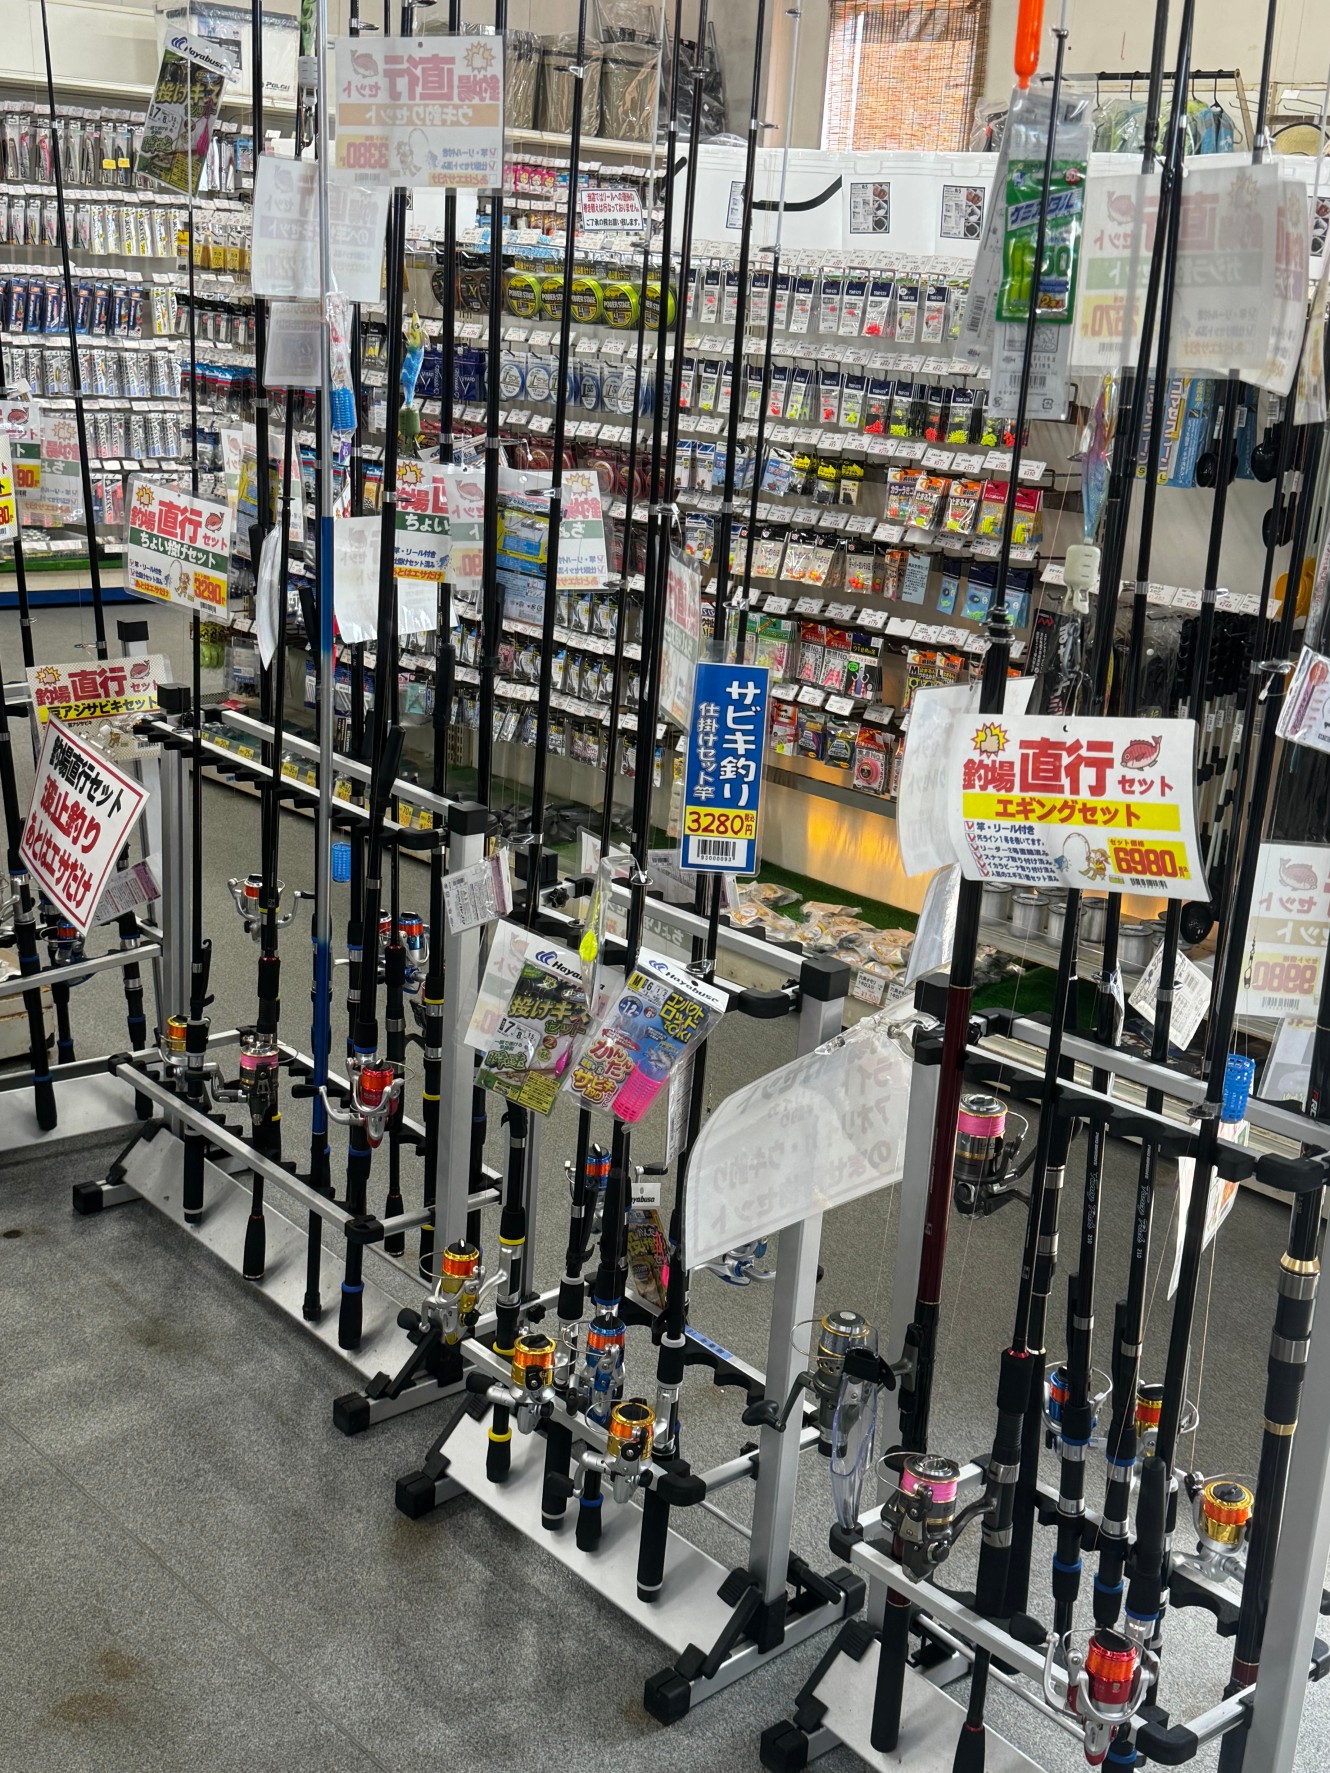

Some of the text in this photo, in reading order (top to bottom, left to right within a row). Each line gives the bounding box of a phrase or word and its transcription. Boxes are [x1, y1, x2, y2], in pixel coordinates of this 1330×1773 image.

[130, 499, 228, 551] 釣場直行セット
[134, 560, 162, 576] 竿・リール付き
[140, 531, 217, 569] ちょい投げセット
[134, 579, 170, 598] あとはエサだけ
[35, 667, 159, 706] 釣場直行セット
[693, 702, 721, 801] 仕掛けセット竿
[719, 680, 761, 807] サビキ釣り
[49, 734, 124, 819] 釣場直行セット
[962, 736, 1174, 798] 釣場直行セット
[40, 774, 102, 855] 波止釣り
[686, 811, 745, 836] 3280
[976, 821, 1035, 836] 竿・リール付き
[995, 798, 1141, 827] エギングセット
[25, 810, 94, 909] あとはエサだけ
[1110, 838, 1145, 848] セット価格
[508, 996, 593, 1026] 投げキス
[659, 1004, 700, 1030] ロッド
[667, 992, 705, 1019] コンパクト
[590, 1040, 635, 1078] かんたん
[573, 1068, 619, 1102] サビキ釣り
